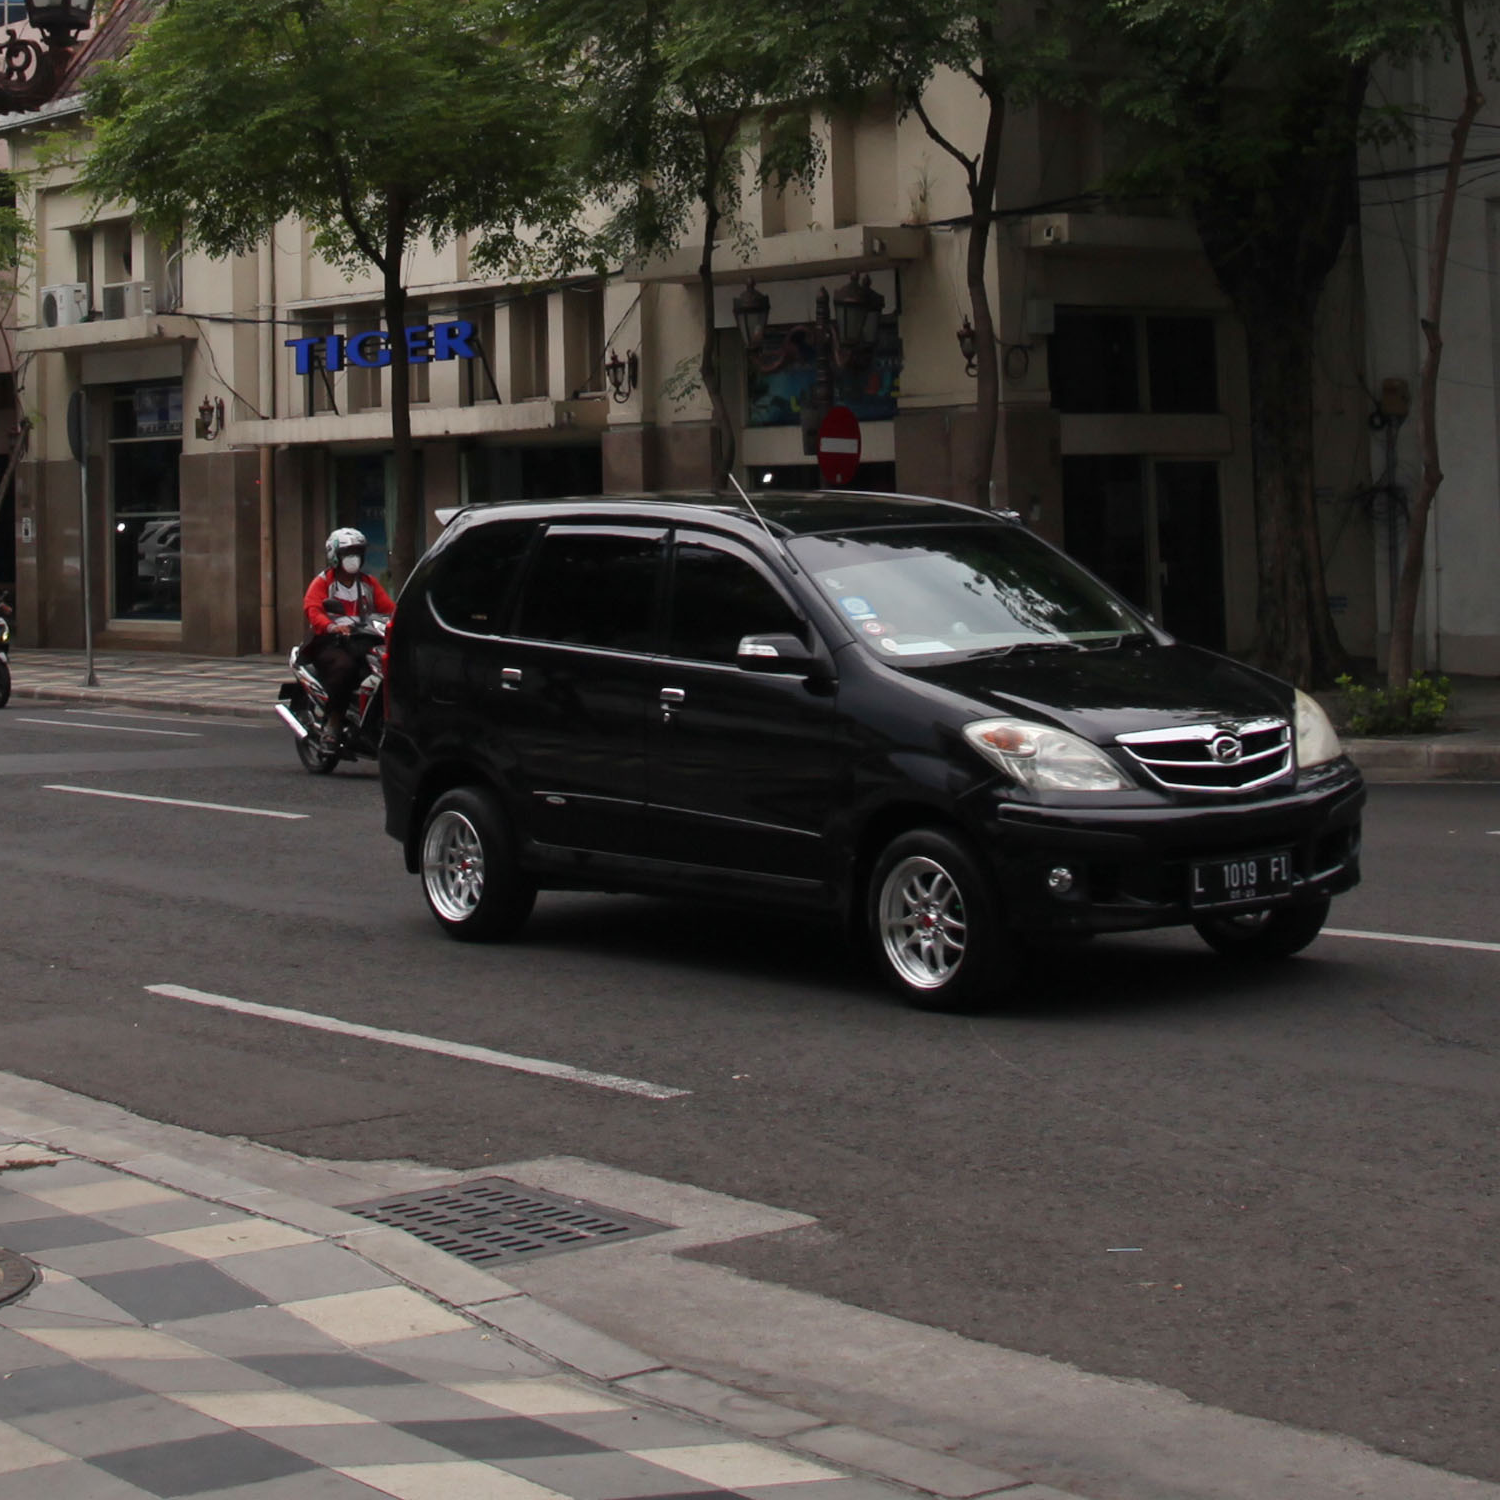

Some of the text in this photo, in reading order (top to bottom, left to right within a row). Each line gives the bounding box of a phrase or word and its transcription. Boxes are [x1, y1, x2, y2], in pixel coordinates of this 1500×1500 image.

[284, 320, 475, 375] TIGER
[1194, 856, 1288, 892] L 1019 FI
